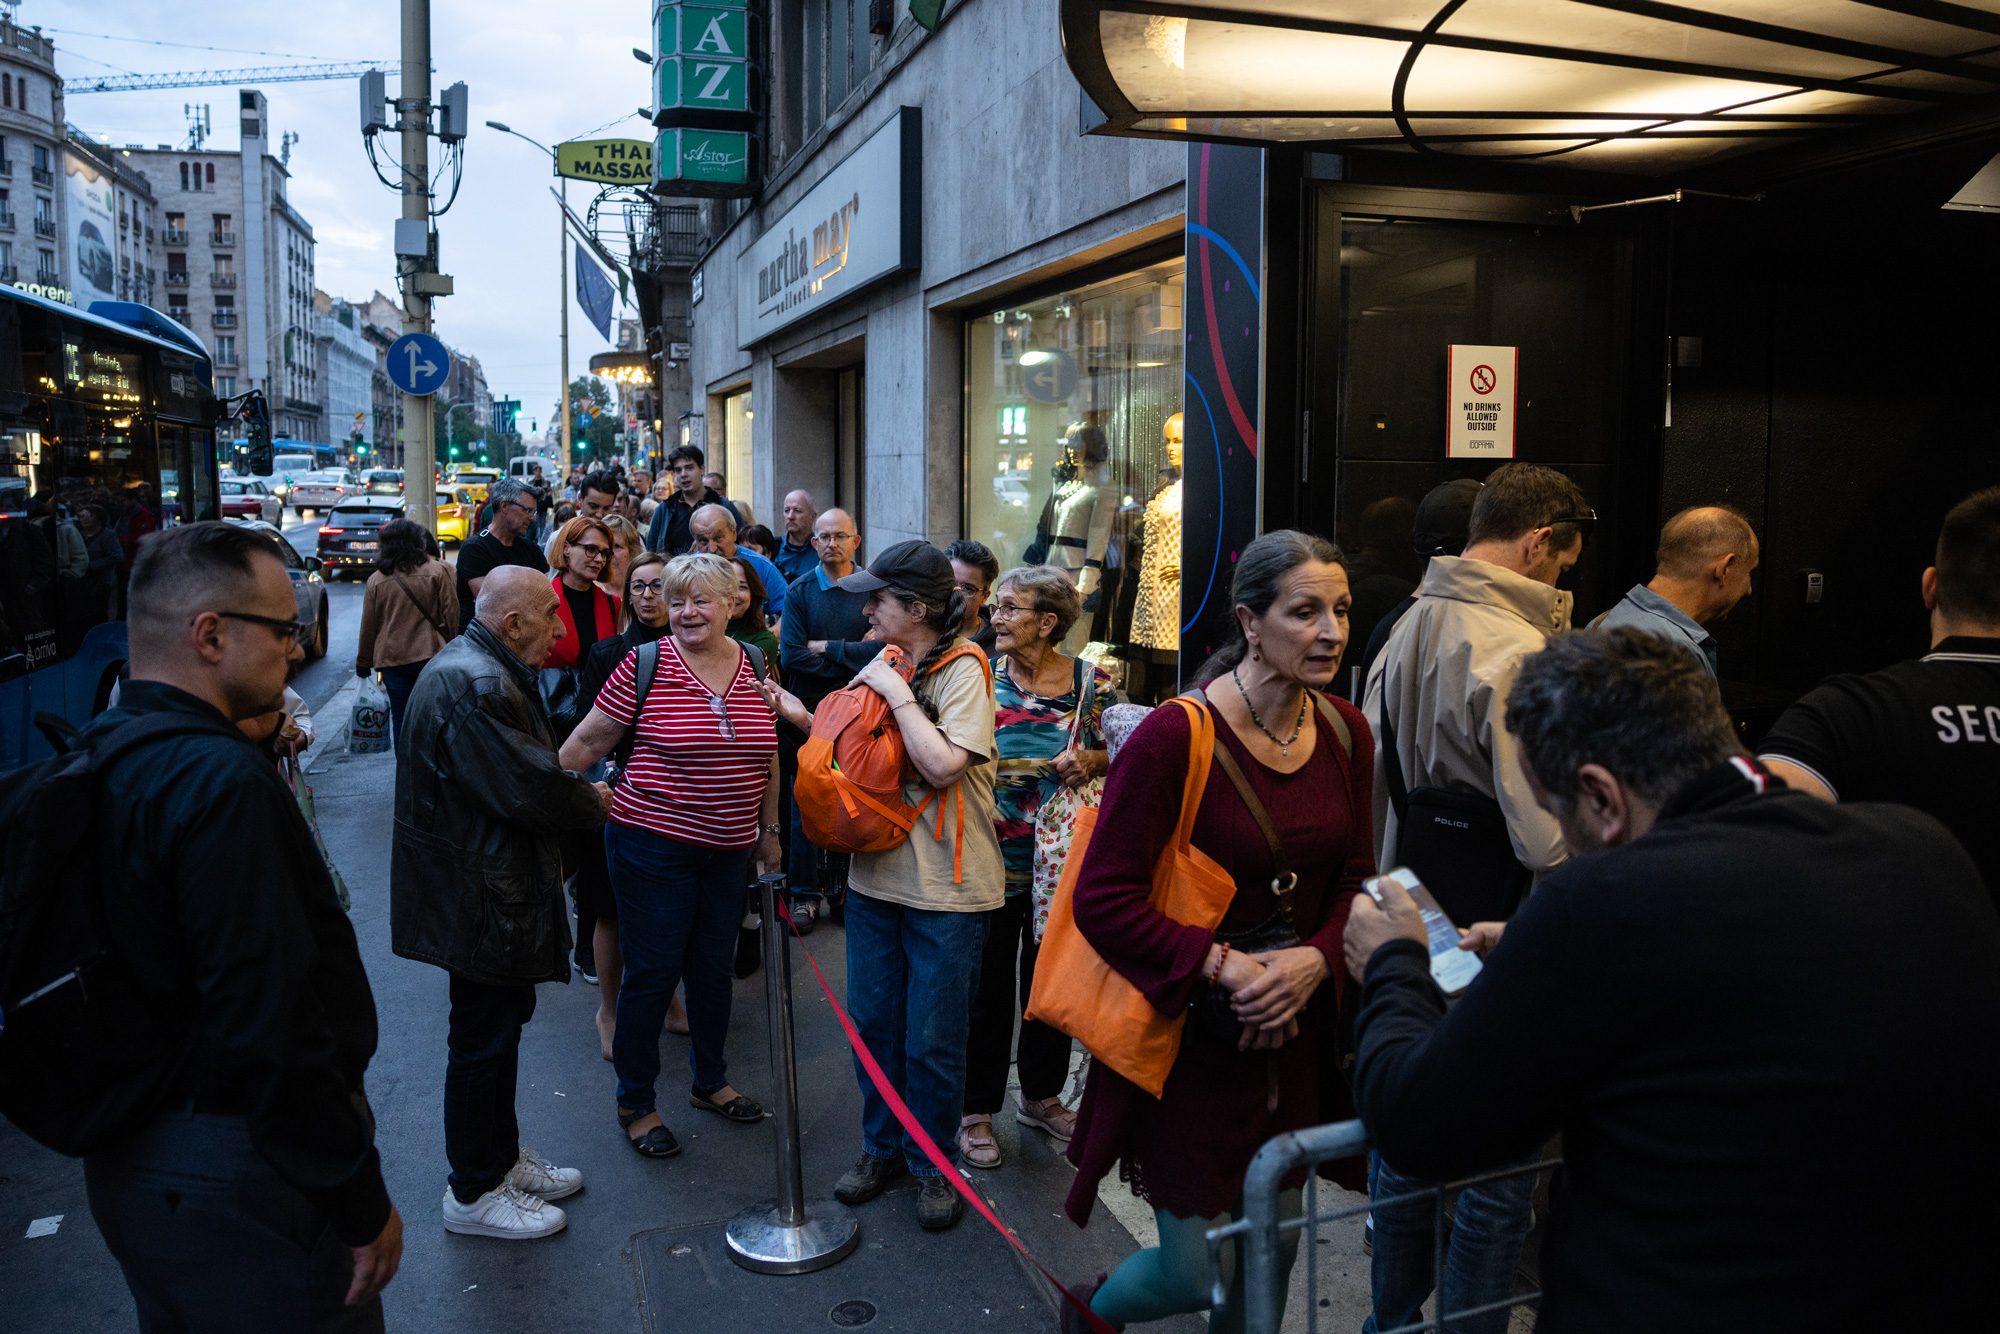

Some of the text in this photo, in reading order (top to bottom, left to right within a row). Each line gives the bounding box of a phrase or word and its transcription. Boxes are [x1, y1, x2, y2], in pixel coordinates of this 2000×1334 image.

[594, 143, 652, 160] THAI
[683, 139, 734, 163] Astor
[758, 227, 809, 305] martha
[1463, 402, 1502, 412] NO DRINKS
[1466, 412, 1498, 422] ALLOWED
[1467, 422, 1497, 431] OUTSIDE
[1930, 704, 2000, 745] SEC
[1434, 816, 1470, 829] POLICE
